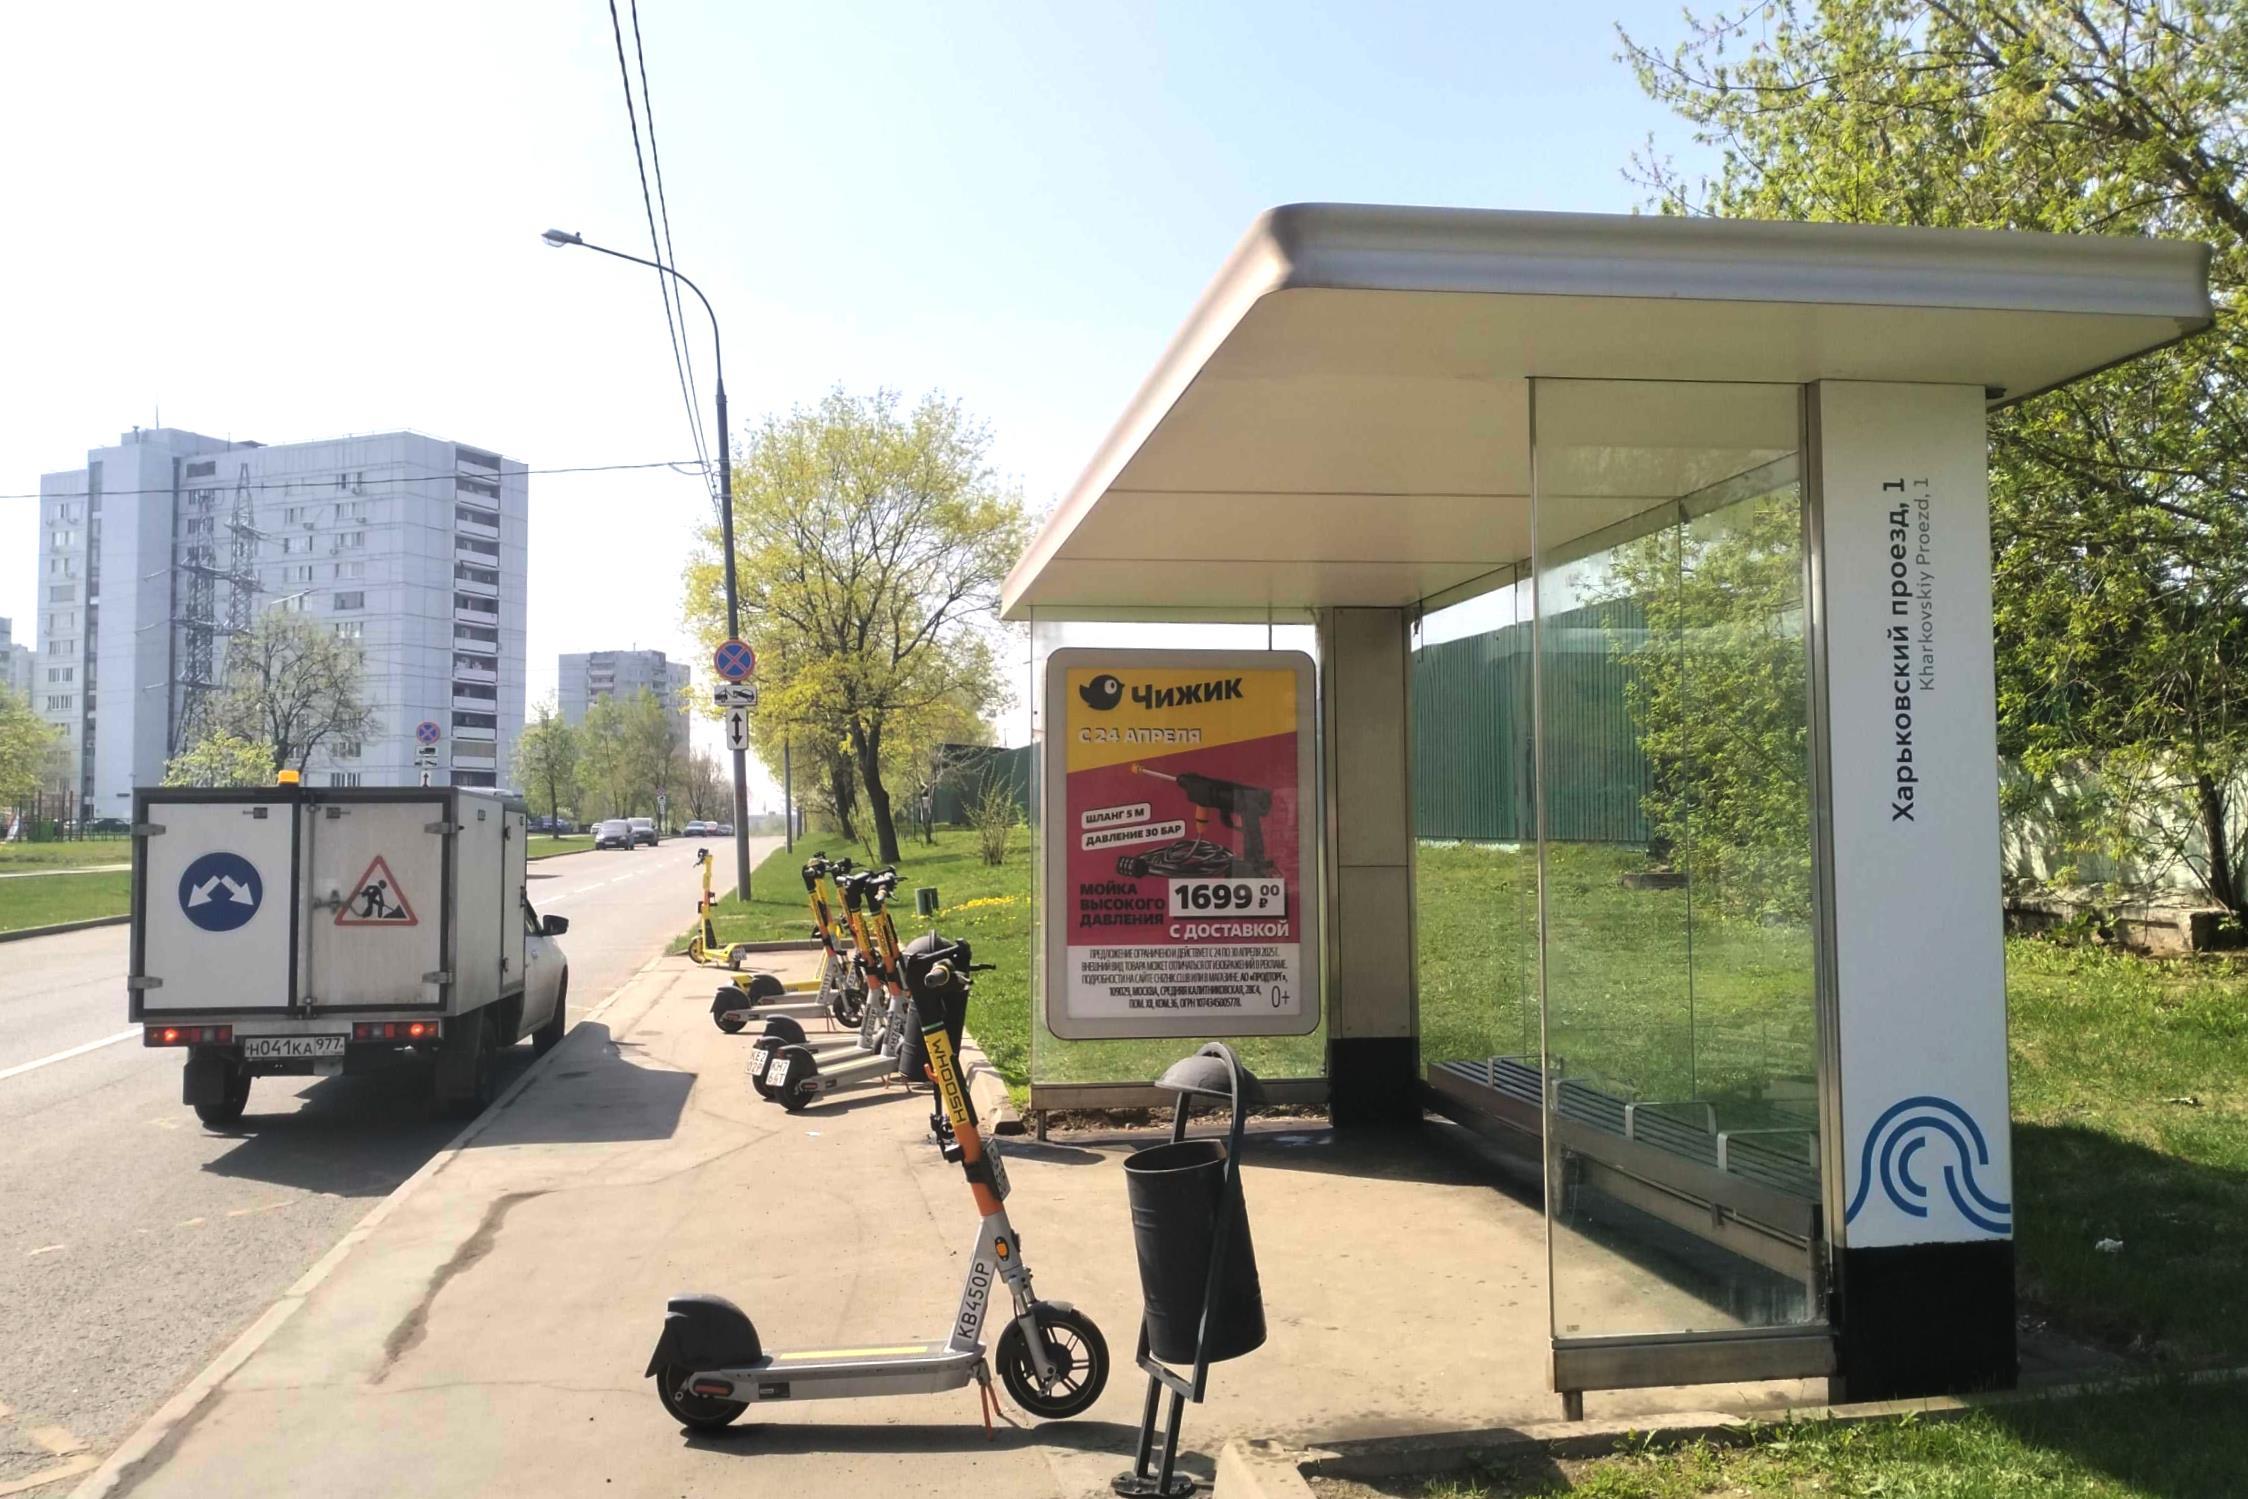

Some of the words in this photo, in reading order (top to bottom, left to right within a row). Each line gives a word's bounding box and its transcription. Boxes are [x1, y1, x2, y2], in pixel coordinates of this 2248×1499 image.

[1883, 478, 1905, 492] 1
[1913, 477, 1929, 488] 1
[1913, 494, 1931, 565] Proezd,
[1889, 502, 1913, 615] проезд,
[1915, 571, 1935, 691] Kharkovskiy
[1887, 626, 1919, 822] Харьковский
[1079, 727, 1092, 744] С
[1094, 727, 1120, 744] 24
[1125, 727, 1202, 744] АПРЕЛЯ
[1085, 811, 1125, 824] ШЛАНГ
[1126, 810, 1133, 818] 5
[1134, 808, 1145, 817] М
[1085, 830, 1143, 847] ДАВЛЕНИЕ
[1145, 828, 1158, 838] 30
[1160, 825, 1182, 836] БАР
[1080, 882, 1137, 896] МОЙКА
[1174, 884, 1253, 910] 1699
[1260, 885, 1280, 896] 00
[1080, 898, 1166, 911] ВЫСОКОГО
[1080, 913, 1165, 928] ДАВЛЕНИЯ
[1169, 924, 1180, 938] С
[1184, 919, 1289, 940] ДОСТАВКОЙ
[1089, 949, 1132, 960] ПРЕДЛОЖЕНИЕ
[1271, 985, 1290, 1008] 0+
[315, 1038, 341, 1050] 977
[931, 1038, 967, 1123] WHOOSH
